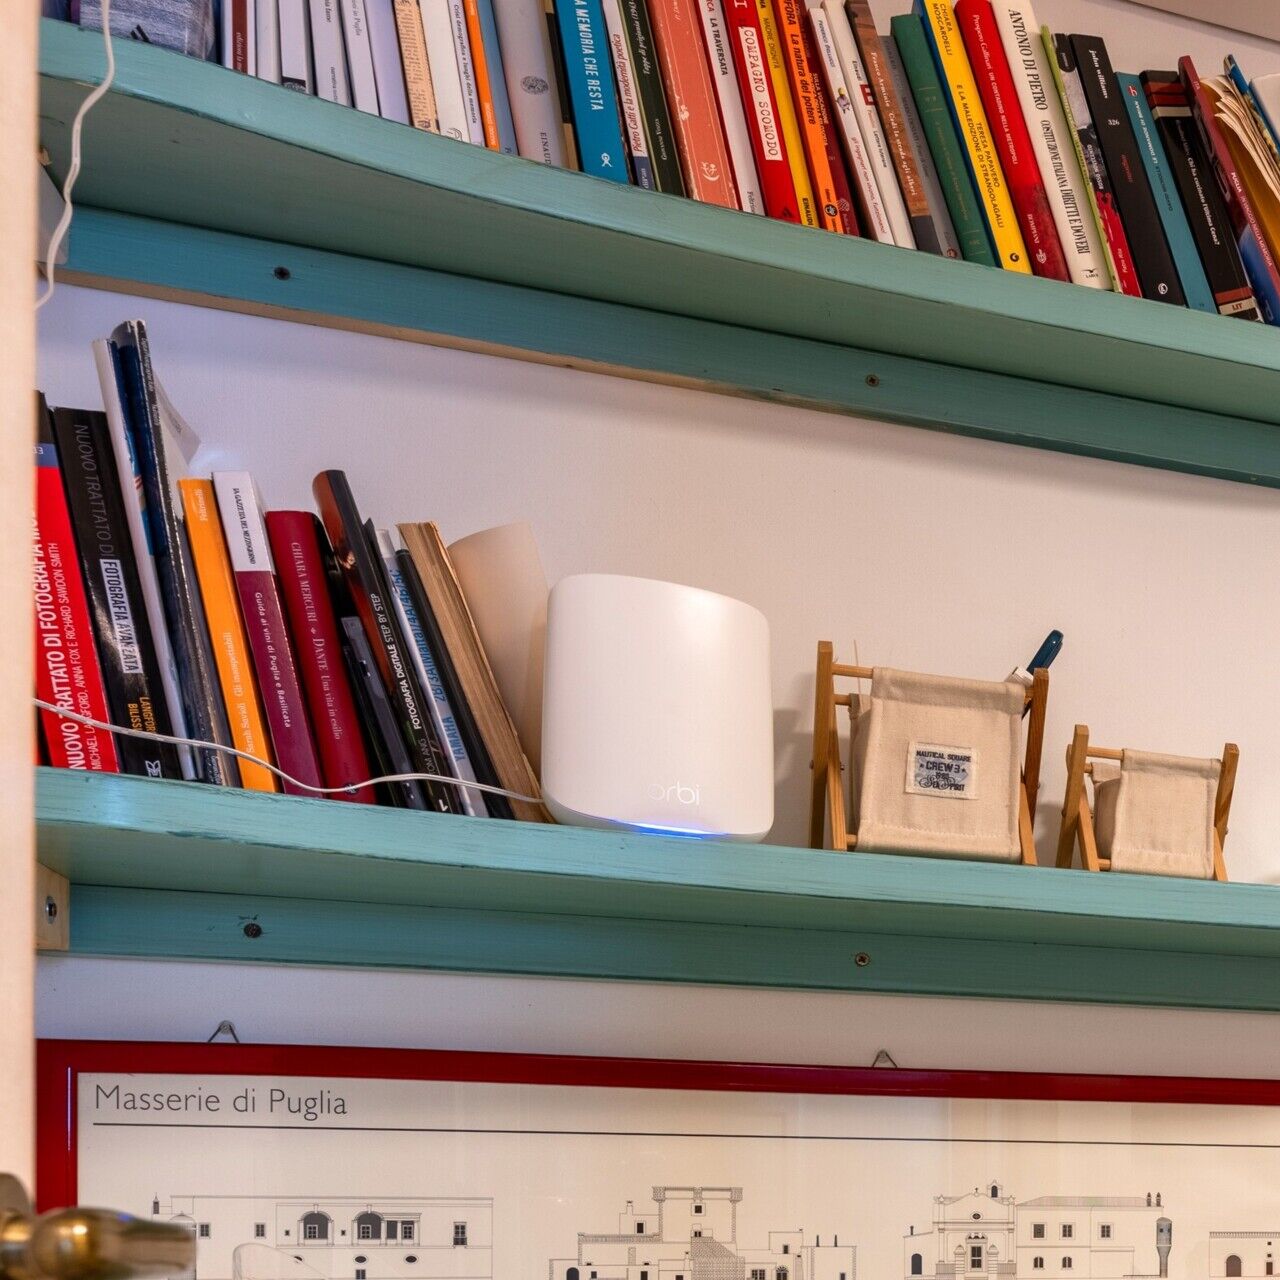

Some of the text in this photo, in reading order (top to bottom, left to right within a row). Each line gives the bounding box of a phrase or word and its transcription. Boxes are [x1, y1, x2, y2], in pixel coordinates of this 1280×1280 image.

[932, 2, 952, 56] MOSCARDELLI
[939, 2, 952, 32] CHIARA
[709, 17, 727, 75] LA TRAVERSATA
[790, 33, 799, 42] La
[576, 8, 602, 110] MEMORIA CHE RESTA
[792, 44, 806, 76] natura
[1007, 8, 1048, 110] ANTONIO DI PIETRO
[1088, 48, 1109, 98] john williams
[743, 29, 778, 155] COMPAGNO SCOMODO
[799, 78, 811, 93] del
[958, 90, 966, 100] LA
[971, 15, 985, 41] Prospero
[987, 72, 994, 80] UN
[991, 81, 1003, 113] CONTADINO
[1000, 114, 1009, 132] NELLA
[1005, 133, 1017, 165] METROPOLI
[802, 95, 816, 124] potere
[870, 52, 882, 76] Franco
[877, 77, 891, 107] Arminio
[887, 112, 898, 128] Cedi
[895, 138, 906, 158] strada
[901, 160, 910, 173] agli
[906, 174, 917, 195] alberi
[1133, 100, 1143, 118] BRIAN
[961, 102, 981, 152] MALEDIZIONE
[1039, 119, 1061, 161] COSTITUZIONE
[1142, 126, 1155, 155] DOMANDE
[975, 122, 999, 187] TERESA PAPAVERO
[976, 154, 984, 162] DI
[1151, 155, 1158, 163] LE
[1186, 157, 1194, 166] Chi
[1051, 161, 1069, 186] ITALIANA
[1189, 168, 1197, 176] ha
[980, 164, 1004, 227] STRANGOLAGALLI
[1059, 188, 1080, 217] DIRITTI
[1192, 177, 1206, 203] cucinato
[1069, 224, 1091, 254] DOVERI
[1209, 227, 1220, 245] Cena?
[1232, 302, 1242, 310] LIT
[73, 424, 116, 556] NUOVO TRATTATO DI
[234, 494, 245, 519] GAZZETTA
[242, 530, 256, 564] MEZZOGIORNO
[47, 542, 62, 567] SMITH
[34, 542, 58, 630] FOTOGRAFIA
[53, 569, 69, 604] SAWDON
[103, 560, 139, 671] FOTOGRAFIA AVANZATA
[254, 591, 265, 615] Guida
[60, 605, 77, 640] RICHARD
[260, 617, 268, 625] ai
[262, 627, 272, 642] vini
[42, 633, 62, 647] DI
[266, 644, 274, 652] di
[290, 542, 342, 739] CHIARA MERCURI DANTE Una vita in esilio
[68, 648, 81, 663] FOX
[267, 655, 280, 680] Puglia
[370, 593, 422, 729] FOTOGRAFIA DIGITALE STEP BY STEP
[72, 666, 86, 688] ANNA
[76, 689, 95, 733] LAGFORD,
[276, 689, 291, 727] Basilicata
[61, 722, 86, 770] NUOVO
[85, 735, 102, 769] MICHAEL
[440, 717, 466, 760] YAMAHA
[916, 750, 972, 762] NAUTICAL SQUARE
[926, 760, 954, 772] CREW
[647, 780, 700, 806] orbi
[96, 1084, 348, 1122] Masserie di Puglia
